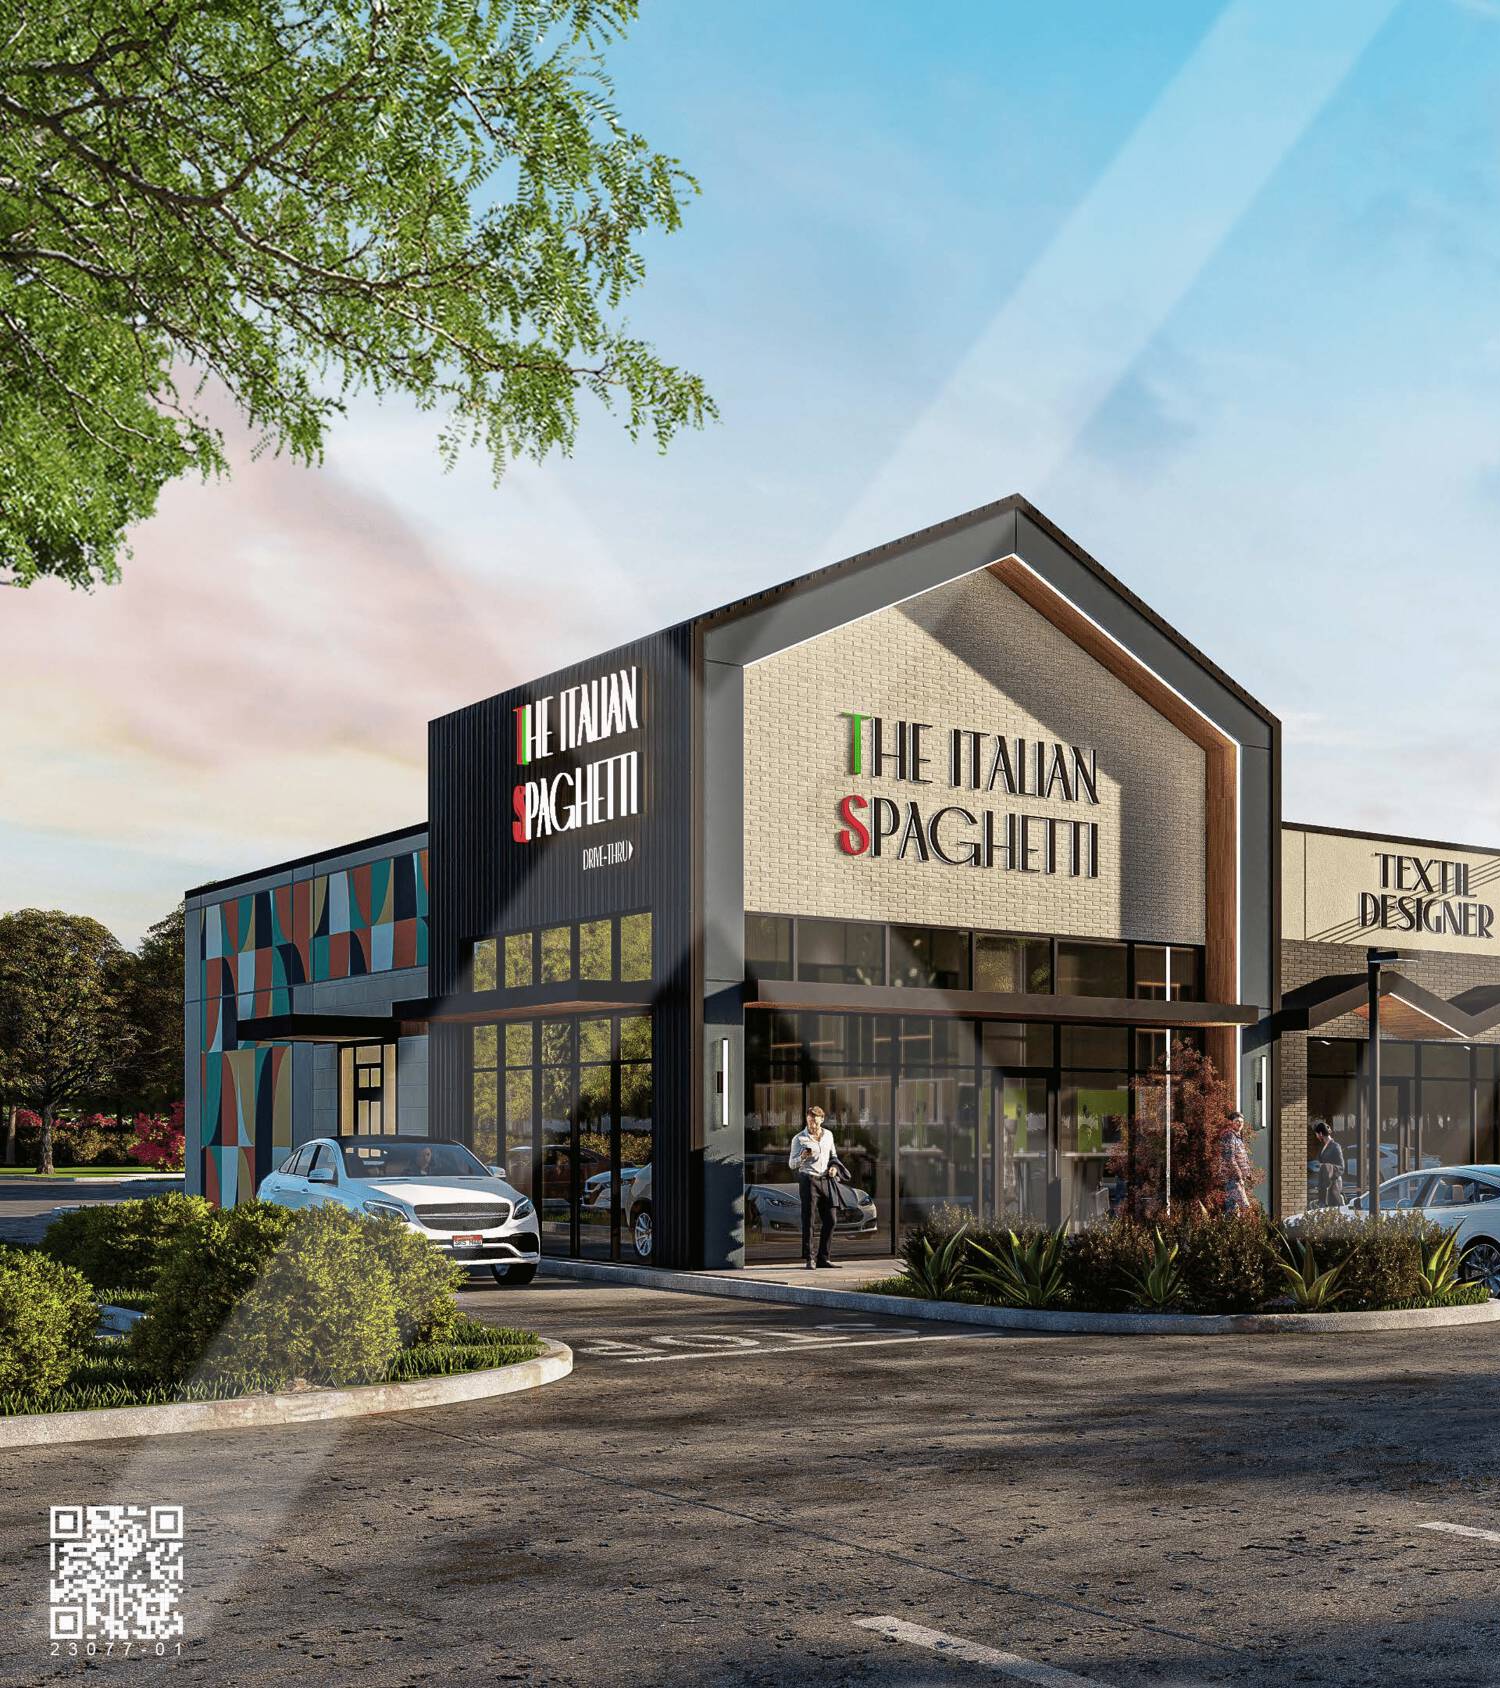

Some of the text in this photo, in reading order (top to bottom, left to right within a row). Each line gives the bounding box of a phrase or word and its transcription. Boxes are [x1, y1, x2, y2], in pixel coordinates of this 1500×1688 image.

[512, 666, 639, 766] THE ITALIAN
[840, 711, 1100, 805] THE ITALIAN
[512, 750, 638, 844] SPAGHETTI
[582, 839, 628, 871] DRIVE-THRU
[838, 794, 1099, 879] SPAGHETTI
[1372, 851, 1477, 898] TEXTIL
[1358, 891, 1494, 940] DESIGNER
[576, 1323, 919, 1357] STOP
